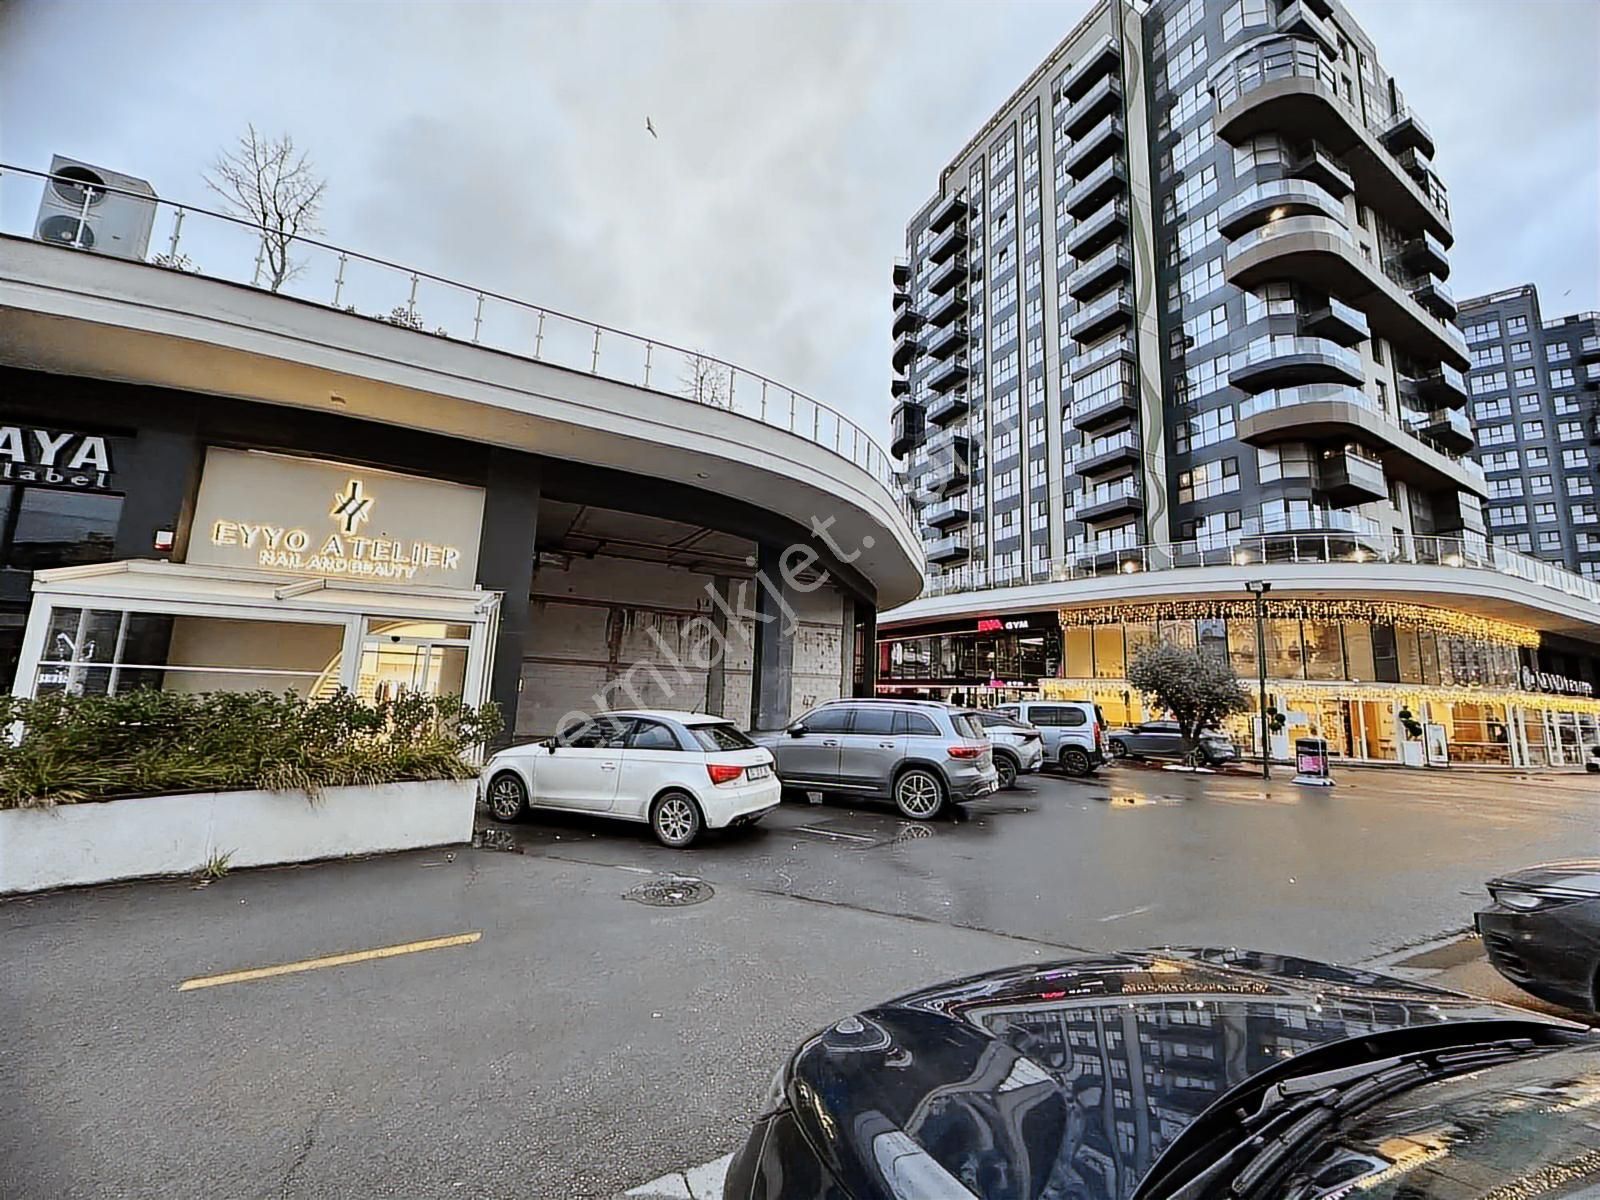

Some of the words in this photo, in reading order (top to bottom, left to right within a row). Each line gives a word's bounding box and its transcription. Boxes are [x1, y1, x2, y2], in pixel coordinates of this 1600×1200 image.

[4, 462, 105, 488] label
[212, 520, 309, 551] EYYO
[321, 534, 460, 569] ATELIER
[259, 550, 304, 569] NAIL
[305, 554, 347, 573] AND
[348, 559, 418, 579] BEAUTY
[1005, 620, 1029, 630] GYM
